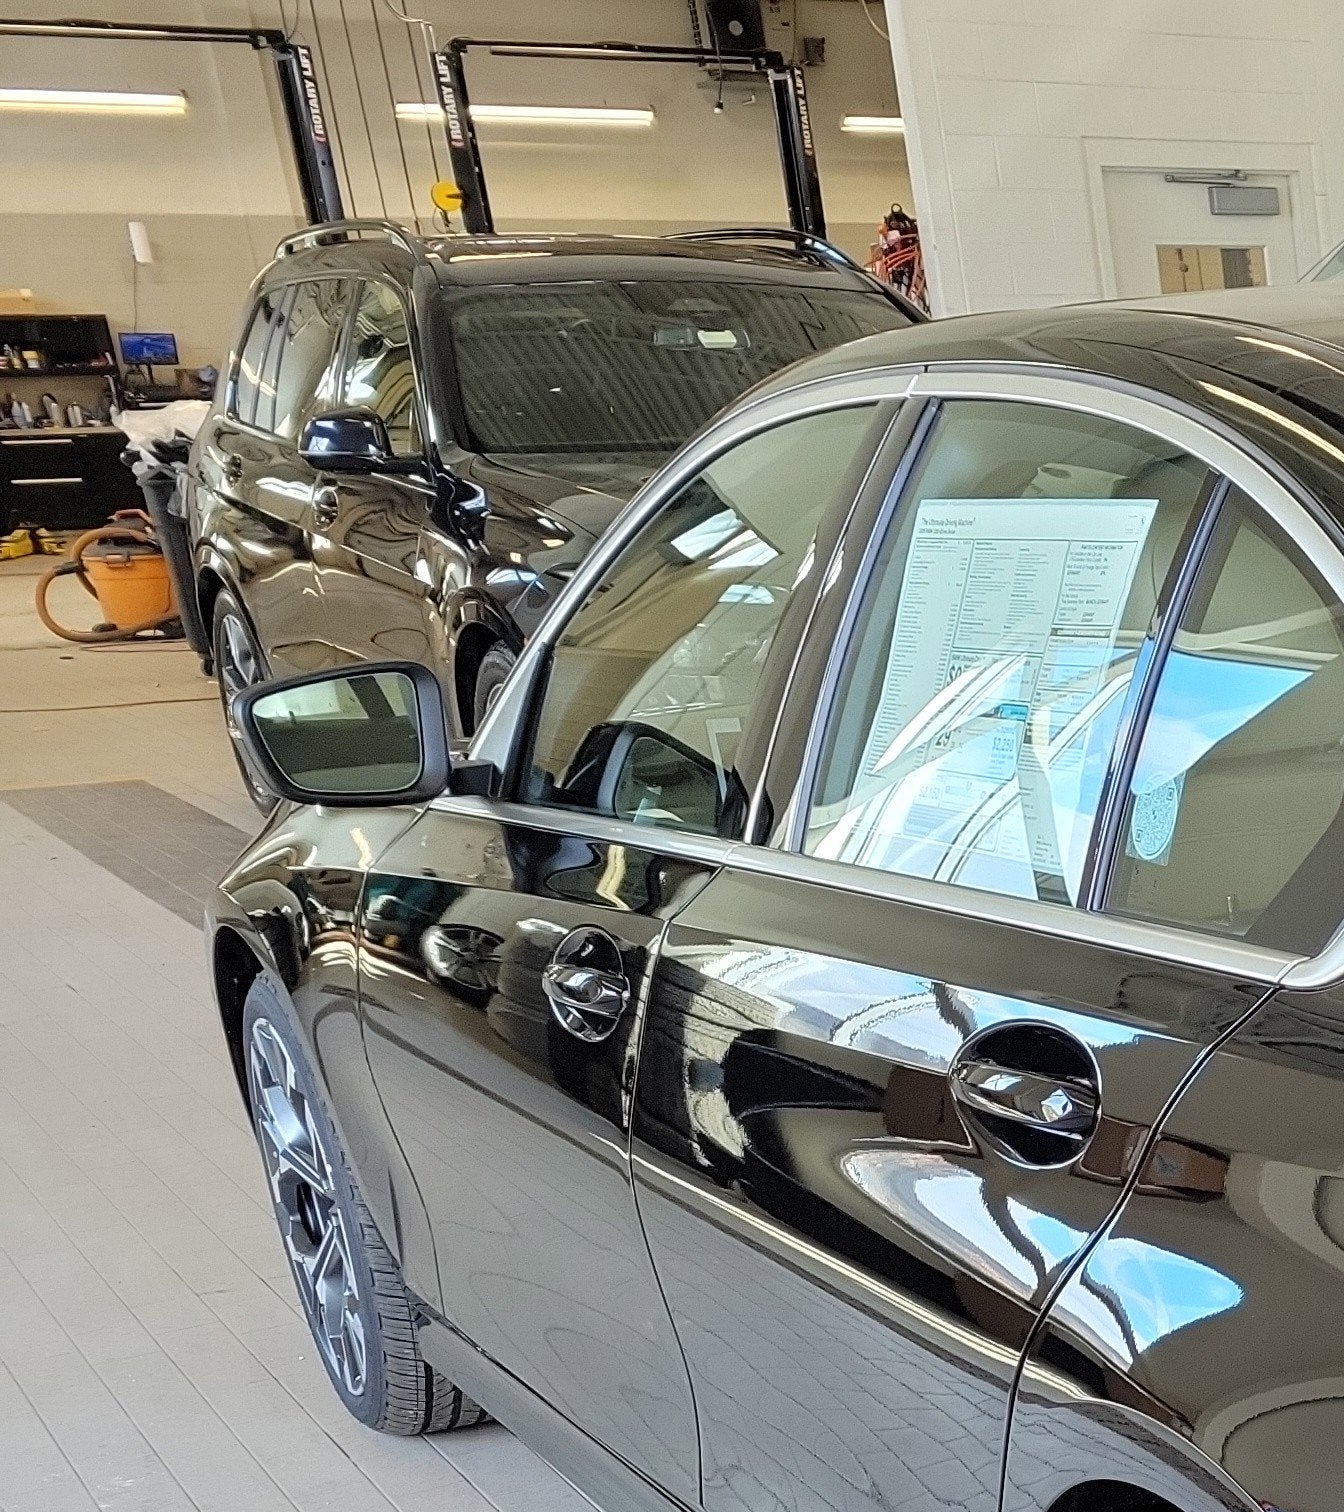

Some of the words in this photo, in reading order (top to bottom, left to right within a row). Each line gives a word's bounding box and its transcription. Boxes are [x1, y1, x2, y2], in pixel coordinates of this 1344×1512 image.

[297, 46, 313, 77] LIFT
[435, 53, 451, 83] LIFT
[793, 67, 805, 95] LIFT
[304, 78, 325, 135] ROTARY
[440, 85, 463, 140] ROTARY
[798, 97, 812, 149] ROTARY
